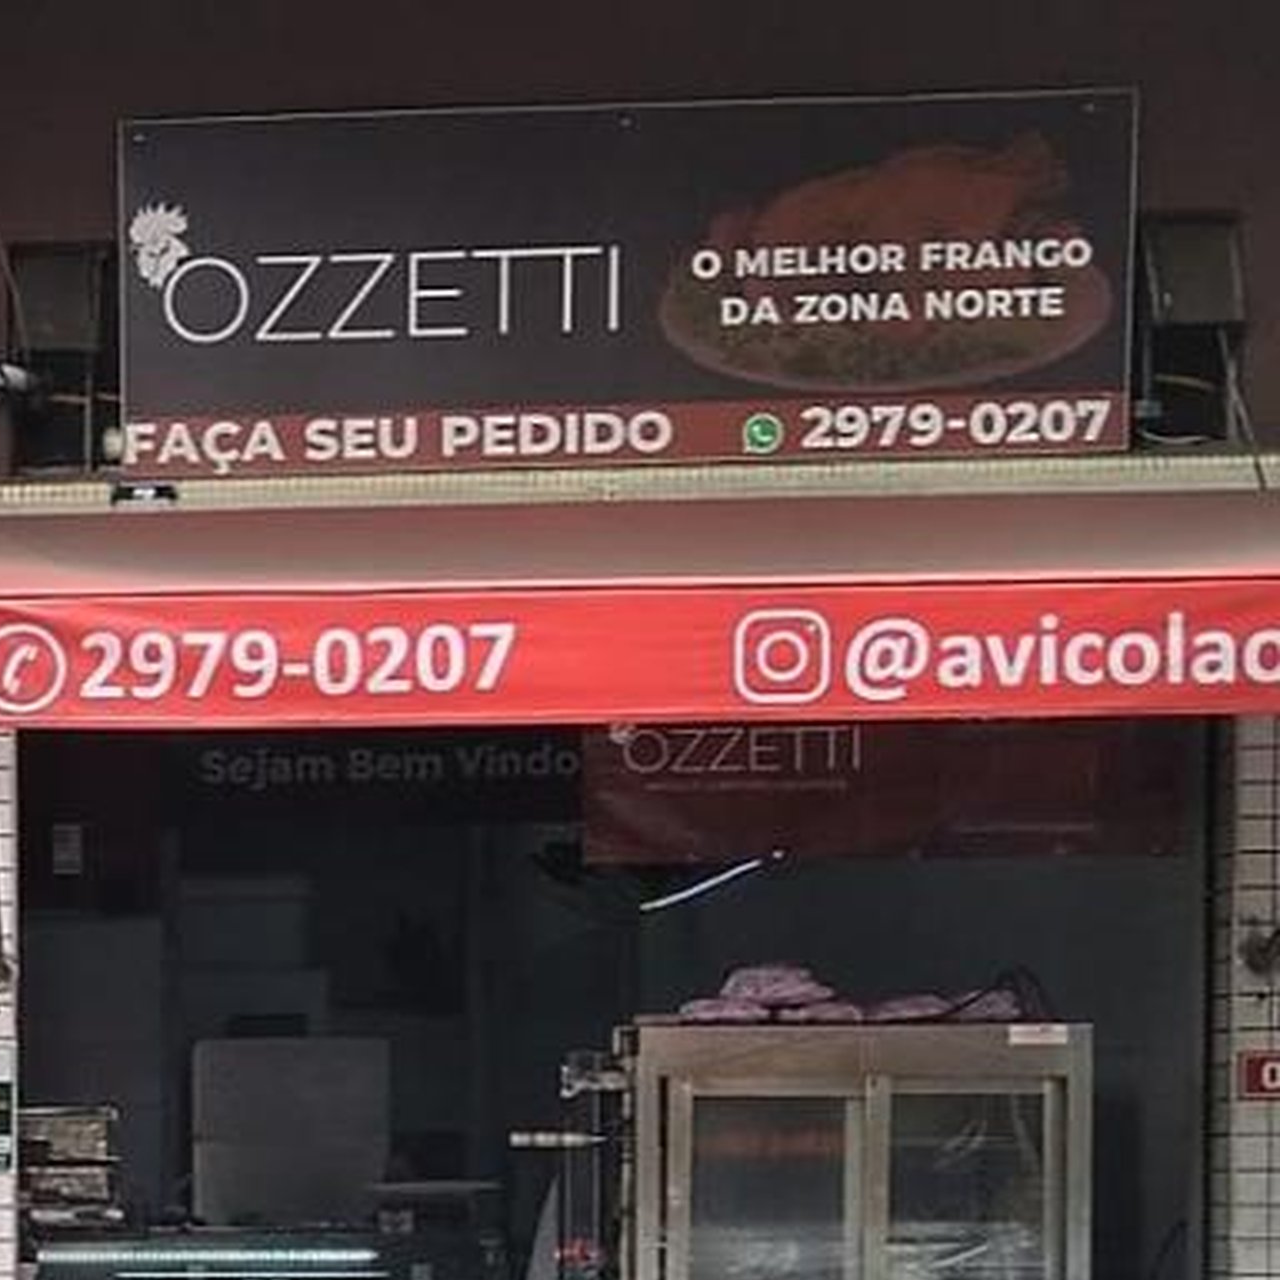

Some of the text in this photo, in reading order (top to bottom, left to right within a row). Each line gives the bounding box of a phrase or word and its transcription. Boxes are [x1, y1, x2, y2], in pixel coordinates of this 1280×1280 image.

[692, 237, 1093, 279] O MELHOR FRANGO
[164, 245, 618, 343] OZZETTI
[721, 287, 1065, 326] DA ZONA NORTE
[124, 411, 673, 475] FAÇA SEU PEDIDO
[800, 398, 1112, 450] 2979-0207
[78, 622, 517, 699] 2979-0207
[845, 610, 1280, 702] @avicolao
[200, 749, 335, 790] Sejam
[346, 747, 440, 781] Bem
[623, 725, 862, 773] OZZETTI
